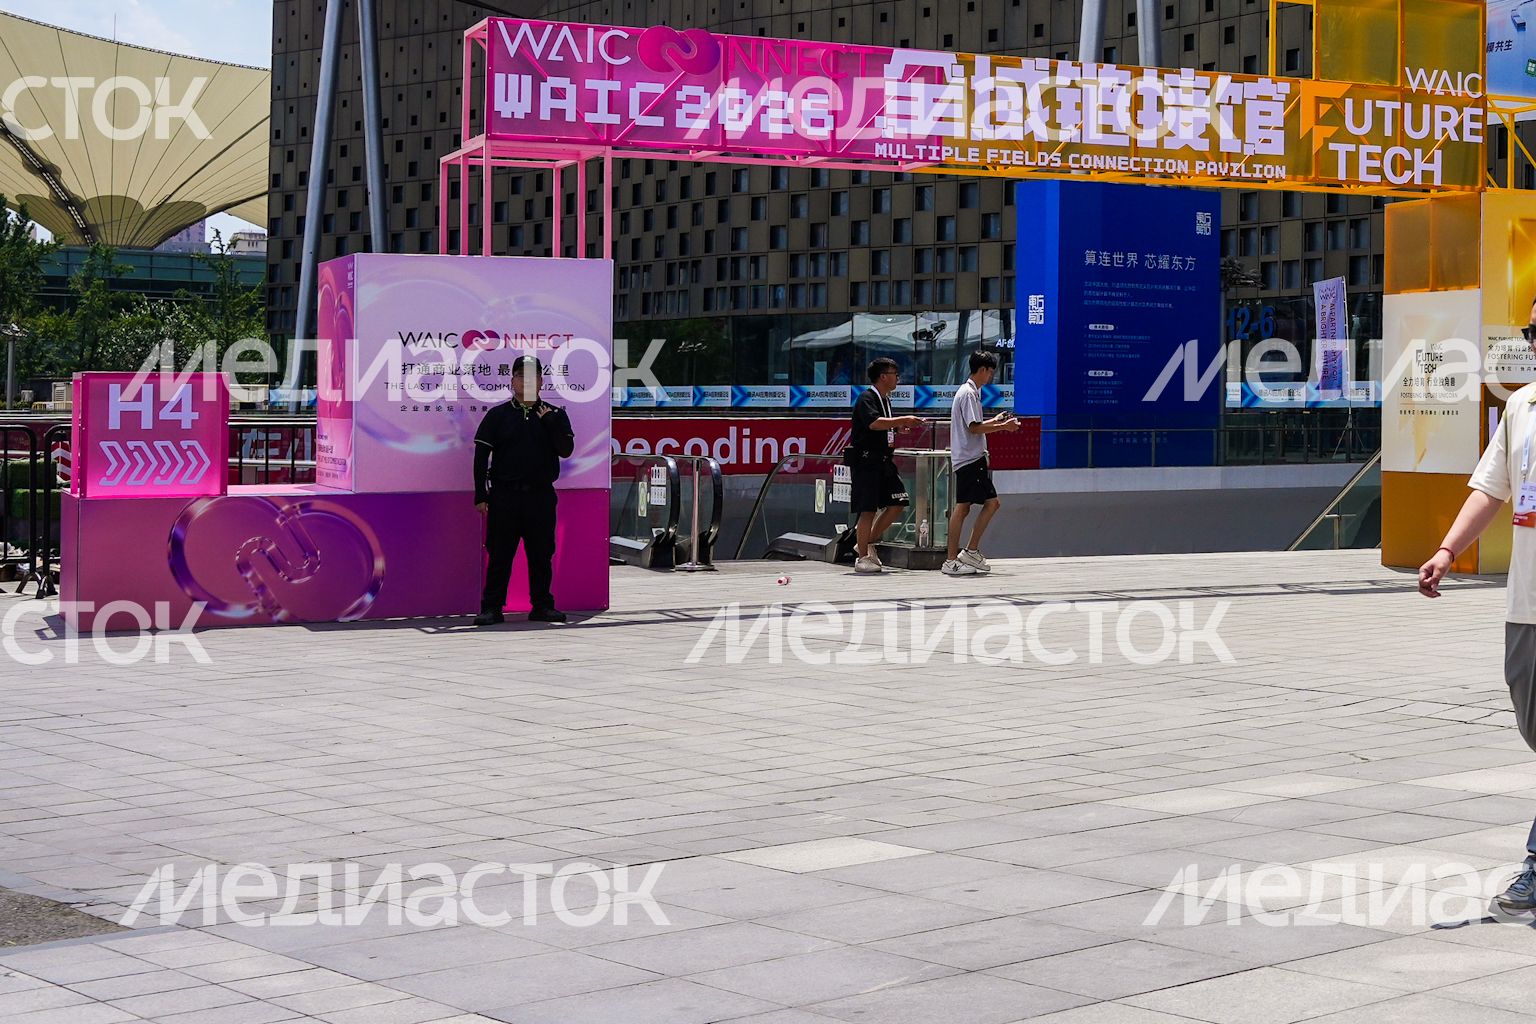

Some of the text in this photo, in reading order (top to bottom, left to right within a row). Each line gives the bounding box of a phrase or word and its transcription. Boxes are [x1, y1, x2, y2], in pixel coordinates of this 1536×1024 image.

[497, 20, 632, 65] WAIC
[1405, 66, 1483, 99] WAIC
[874, 142, 1287, 180] MULTIPLE FIELDS CONNECTION PAVILION
[1328, 142, 1443, 186] TECH
[1083, 249, 1197, 271] 算连世界 芯耀东方
[398, 331, 459, 349] WAIC
[401, 362, 570, 377] 打通商业落地 最公里
[384, 382, 405, 390] THE
[435, 383, 458, 391] MILE
[461, 383, 475, 391] OF
[478, 383, 586, 391] COMMLIZATION
[108, 383, 199, 430] H4
